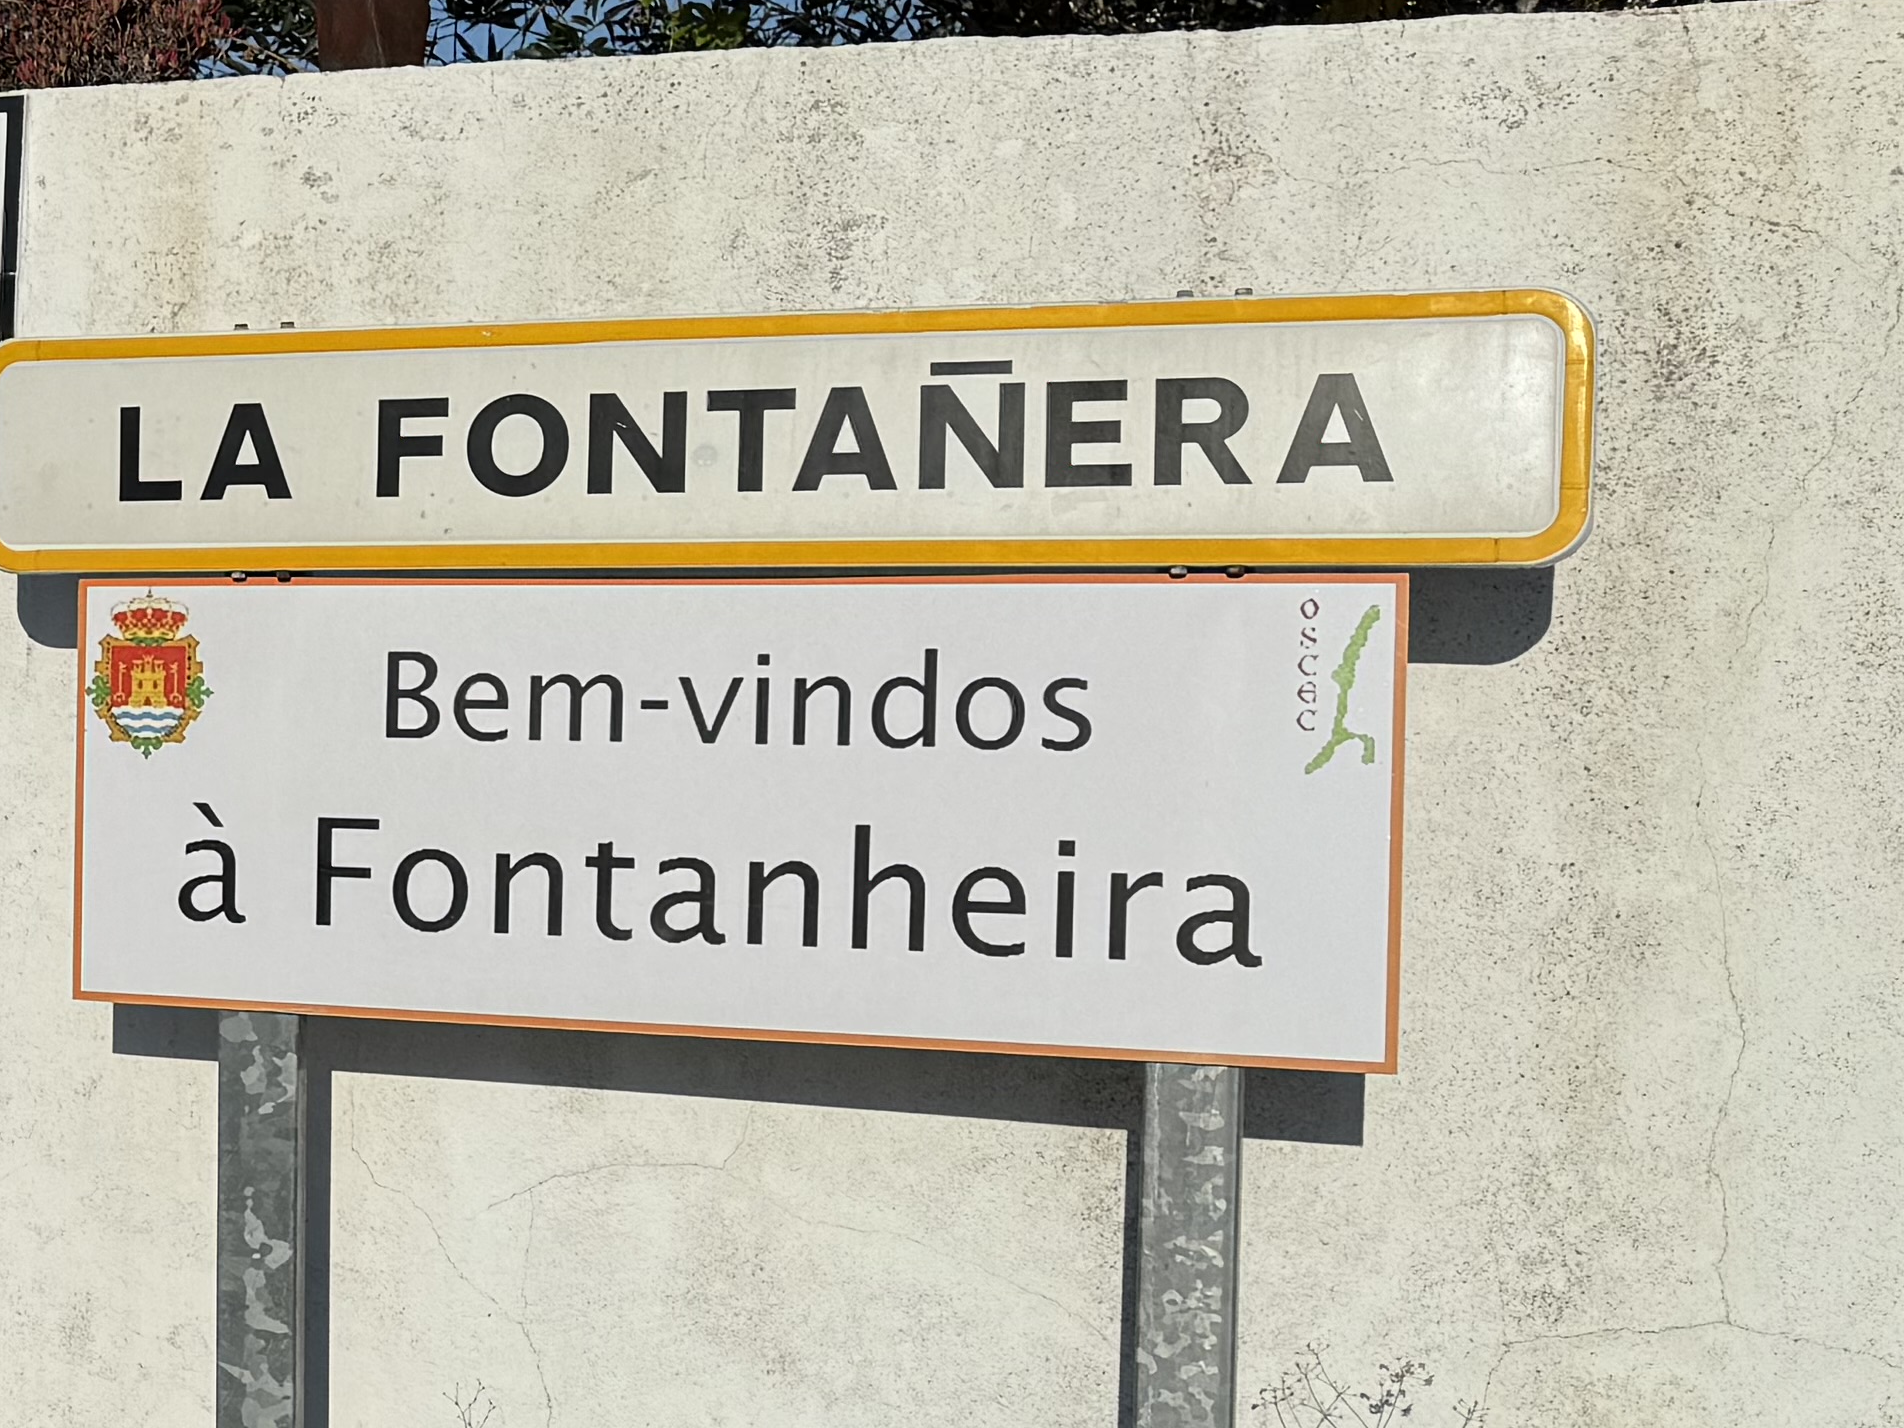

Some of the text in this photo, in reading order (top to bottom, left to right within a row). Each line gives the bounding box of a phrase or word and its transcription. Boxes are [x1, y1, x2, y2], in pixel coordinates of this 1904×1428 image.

[118, 358, 1395, 503] LA FONTAÑERA
[385, 647, 1094, 753] Bem-vindos
[177, 801, 1265, 969] à Fontanheira
